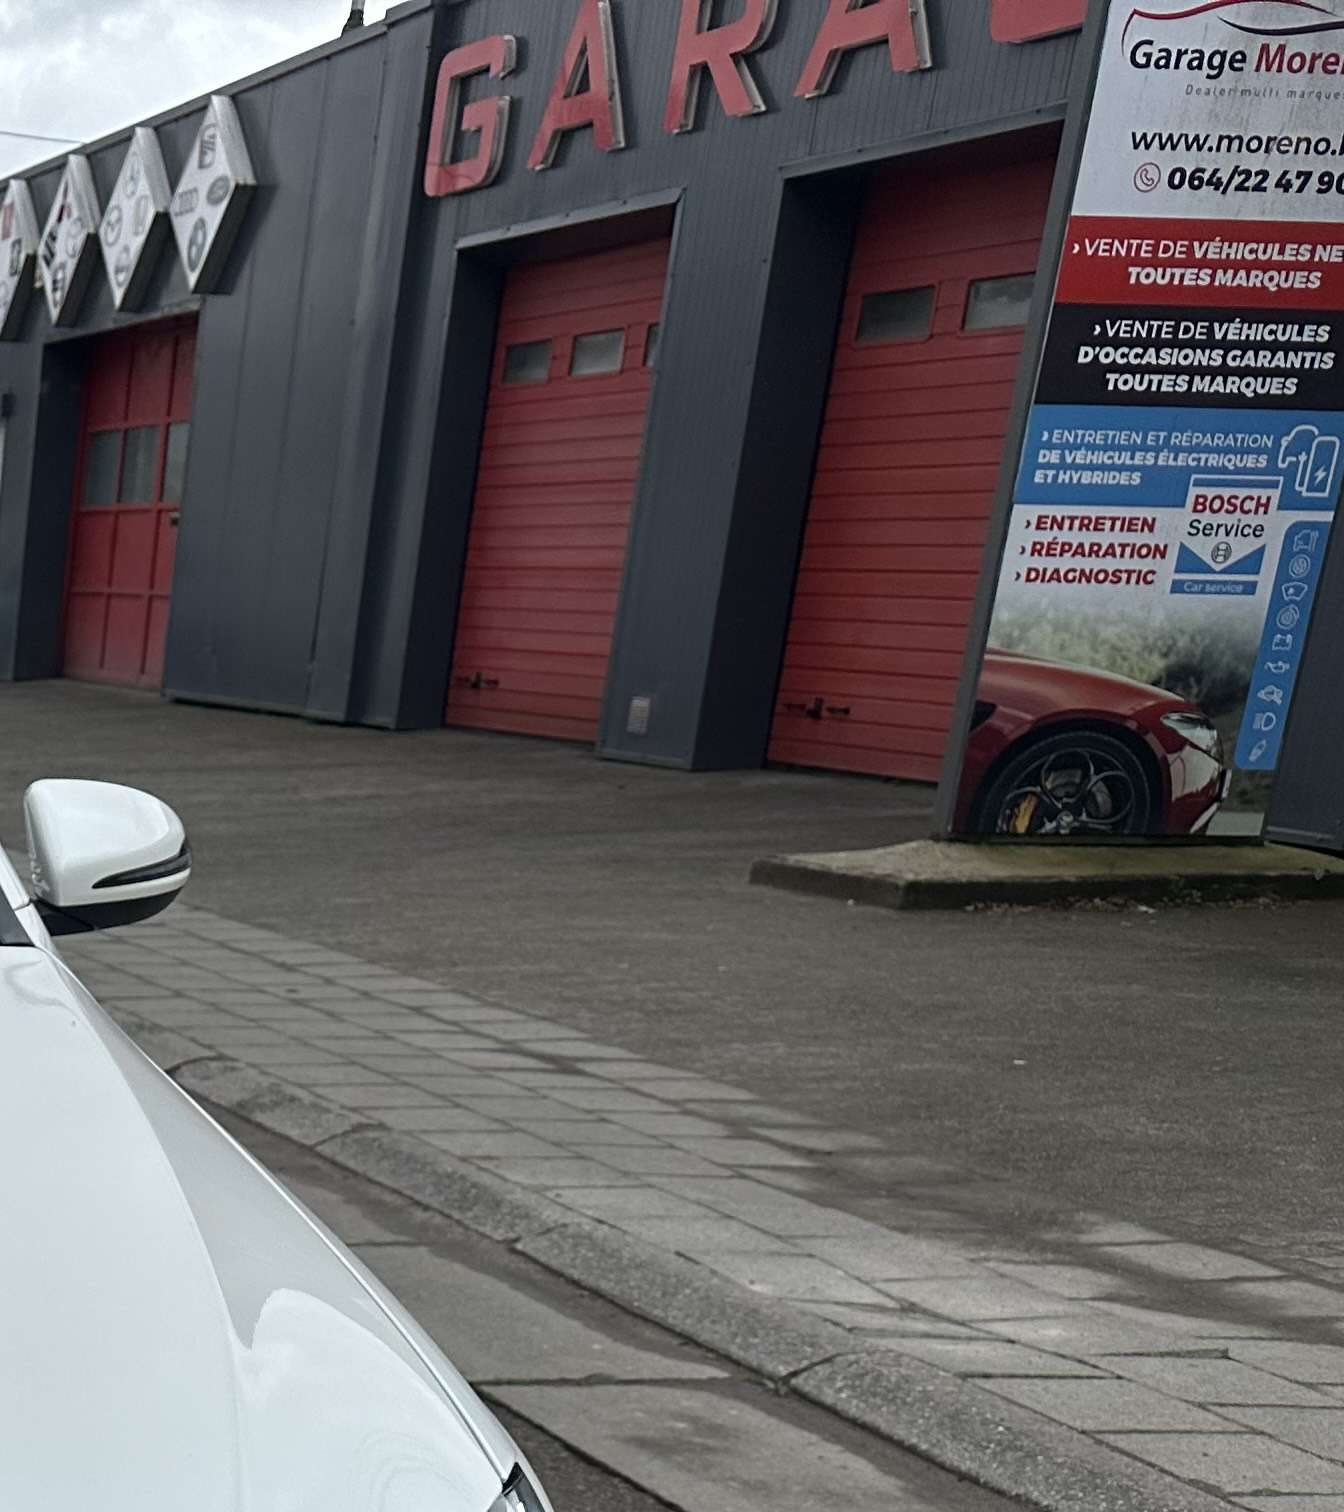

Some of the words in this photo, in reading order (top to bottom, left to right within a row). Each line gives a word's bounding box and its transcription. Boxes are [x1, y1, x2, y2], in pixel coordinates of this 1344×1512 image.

[1129, 39, 1247, 80] Garage
[424, 0, 1084, 197] GARA
[1167, 165, 1270, 195] 064/22
[1274, 170, 1314, 194] 47
[1084, 238, 1154, 258] VENTE
[1158, 240, 1188, 259] DE
[1193, 237, 1312, 262] VÉHICULES
[1128, 266, 1212, 286] TOUTES
[1214, 269, 1322, 292] MARQUES
[1105, 320, 1175, 339] VENTE
[1179, 321, 1209, 340] DE
[1213, 318, 1331, 343] VÉHICULES
[1077, 345, 1224, 367] D'OCCASIONS
[1226, 350, 1336, 370] GARANTIS
[1106, 373, 1189, 393] TOUTES
[1192, 375, 1299, 397] MARQUES
[1052, 429, 1143, 445] ENTRETIEN
[1147, 431, 1165, 446] ET
[1170, 430, 1274, 449] RÉPARATION
[1038, 449, 1060, 464] DE
[1064, 447, 1154, 466] VÉHICULES
[1157, 450, 1268, 470] ÉLECTRIQUES
[1034, 469, 1054, 484] ET
[1057, 470, 1142, 486] HYBRIDES
[1192, 494, 1272, 515] BOSCH
[1035, 515, 1156, 534] ENTRETIEN
[1187, 518, 1265, 538] Service
[1030, 536, 1168, 560] RÉPARATION
[1025, 567, 1157, 586] DIAGNOSTIC
[1183, 582, 1203, 593] Car
